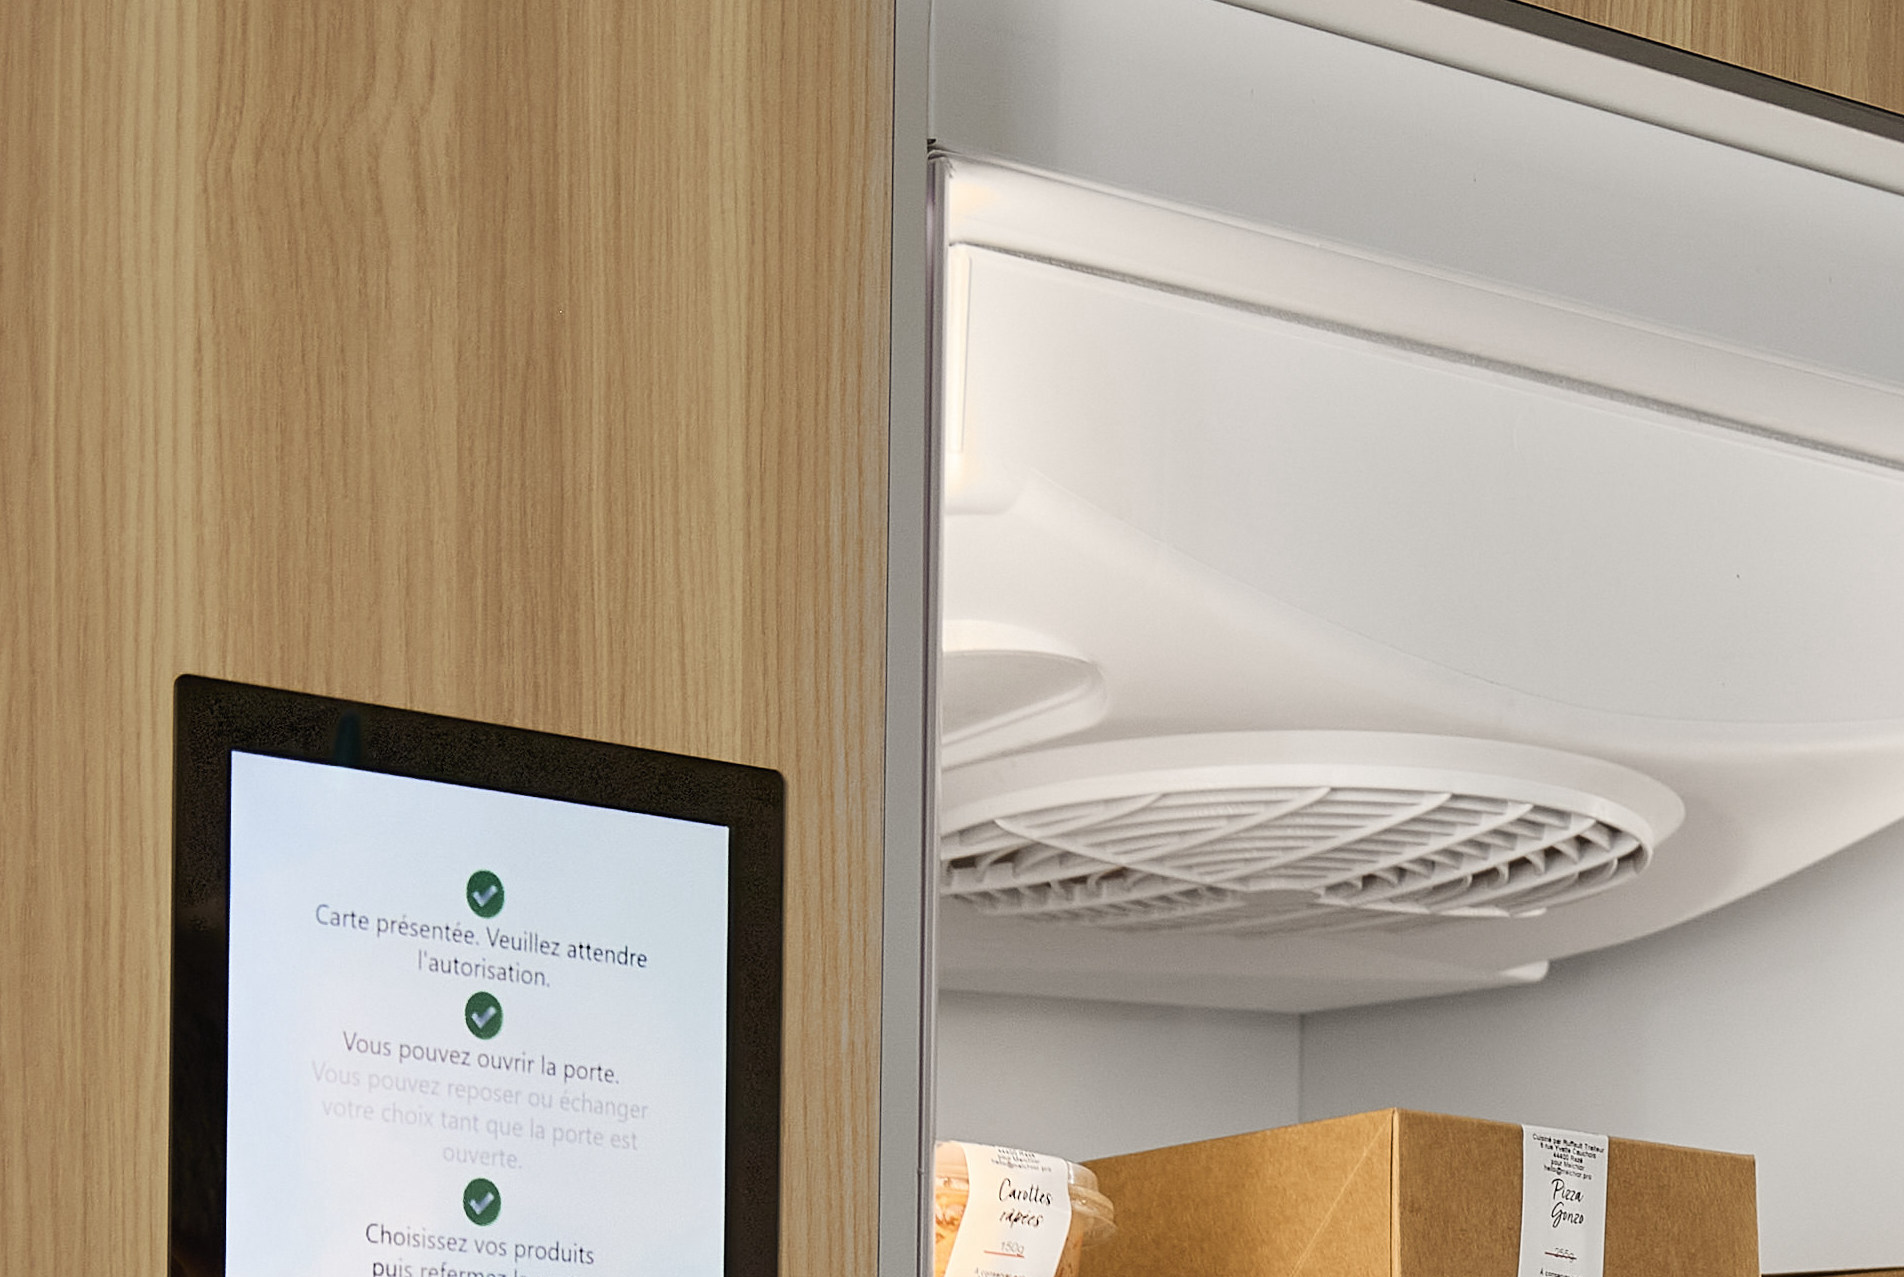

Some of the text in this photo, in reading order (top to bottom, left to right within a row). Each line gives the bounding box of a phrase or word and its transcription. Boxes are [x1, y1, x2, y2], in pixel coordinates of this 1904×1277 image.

[315, 904, 648, 968] Carte présentée. Veuillez attendre
[418, 950, 550, 988] l'autorisation.
[343, 1031, 620, 1085] Vous pouvez ouvrir la porte.
[311, 1061, 649, 1122] Vous pouvez reposer ou échanger
[322, 1100, 638, 1152] votre choix tant que la porte est
[442, 1145, 523, 1170] ouverte.
[998, 1178, 1052, 1206] Carottes
[1552, 1178, 1583, 1202] Pizza
[1551, 1202, 1584, 1228] Gonzo
[365, 1224, 594, 1266] Choisissez vos produits
